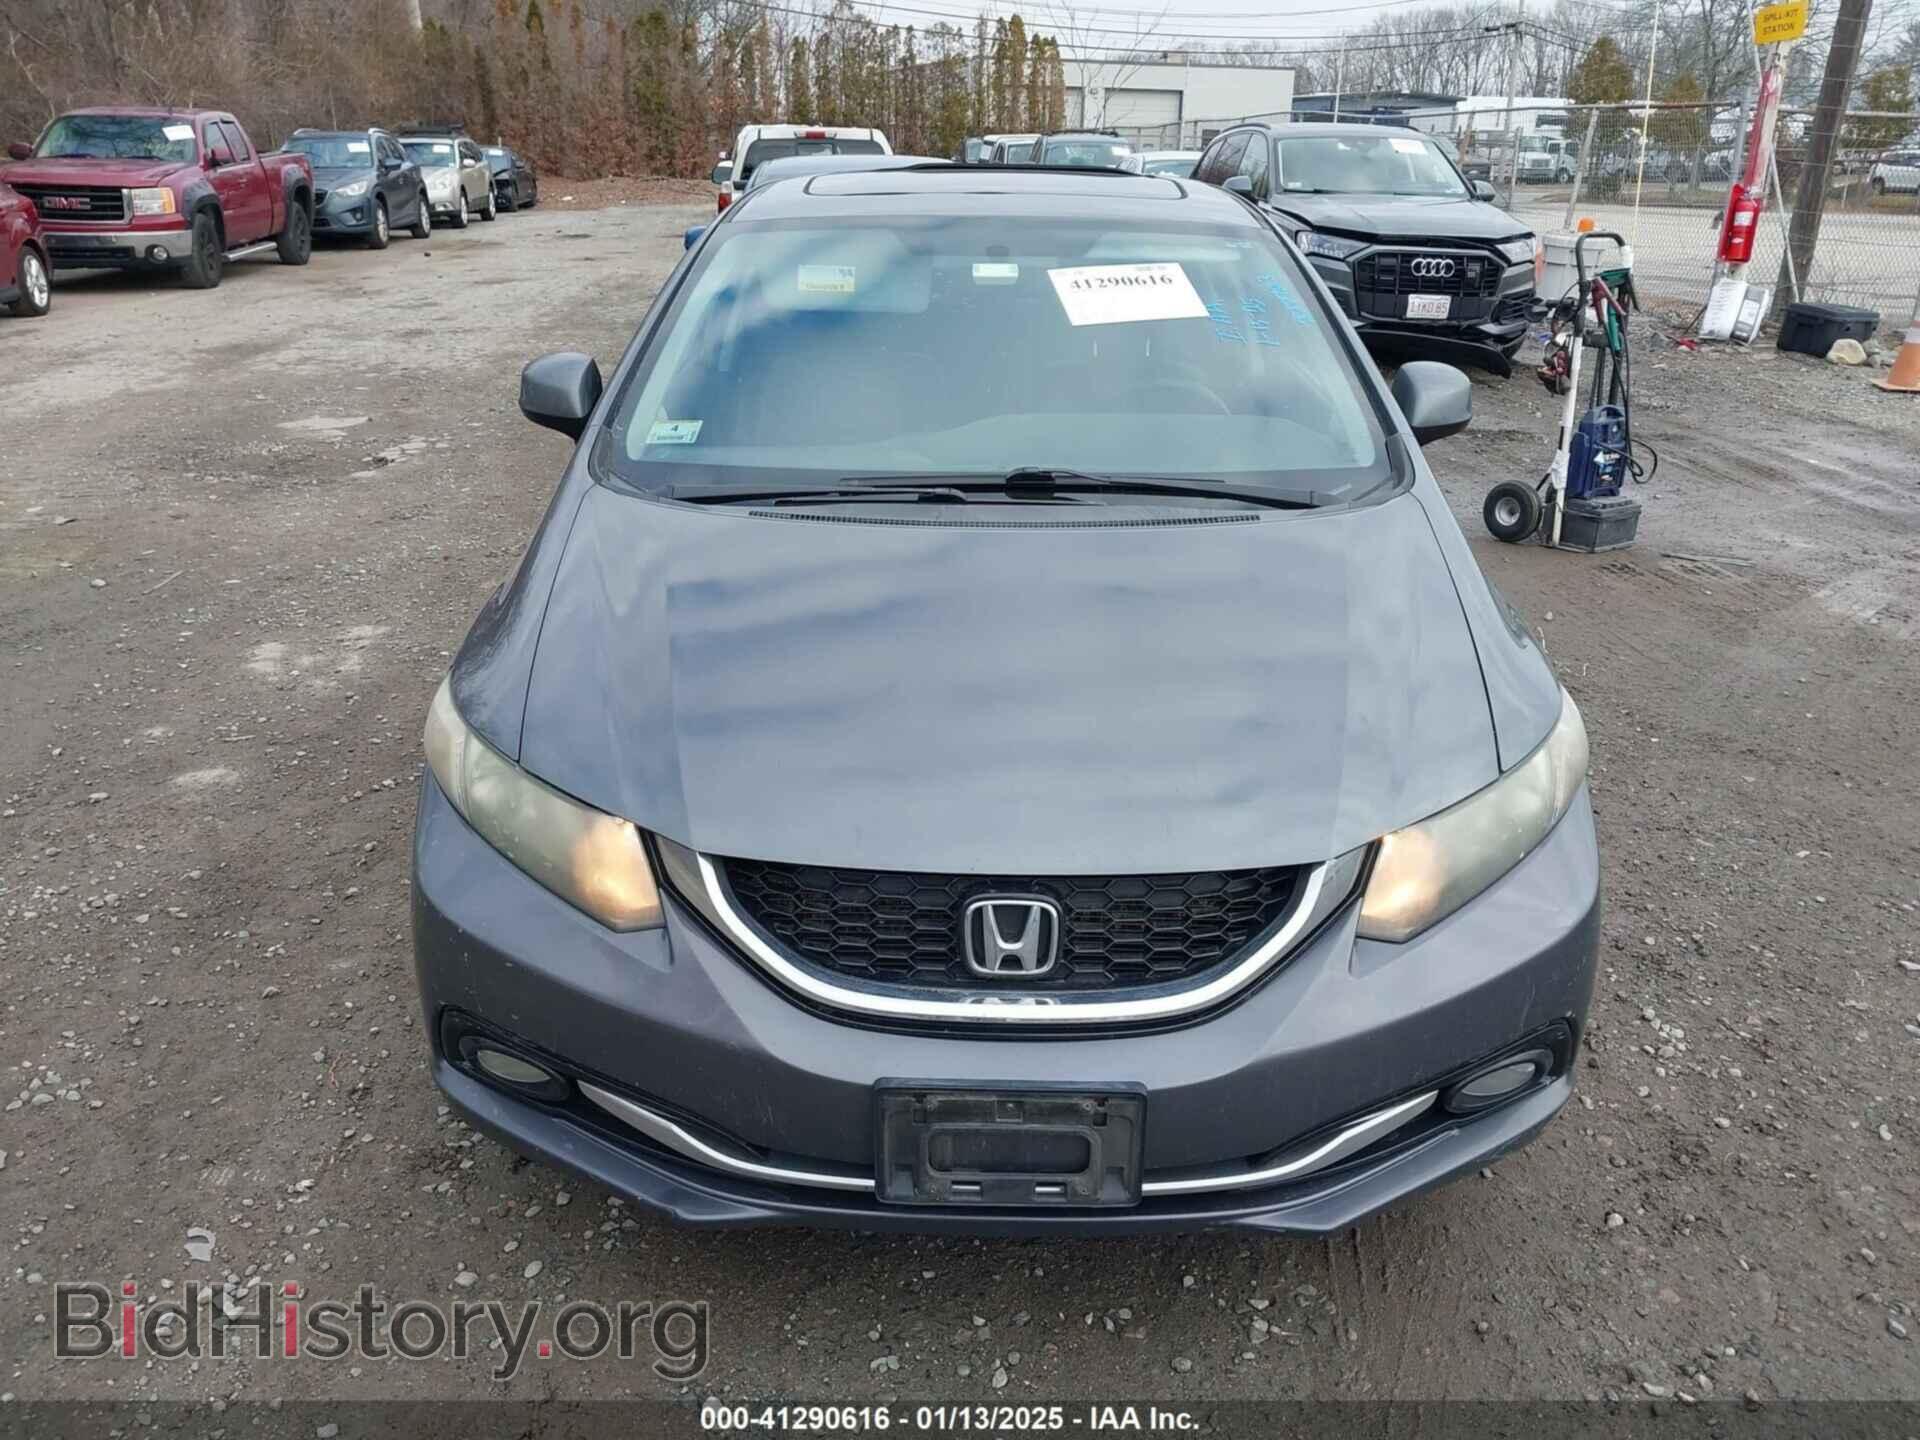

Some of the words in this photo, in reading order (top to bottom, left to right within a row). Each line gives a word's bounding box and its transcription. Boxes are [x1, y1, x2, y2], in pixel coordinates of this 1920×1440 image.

[1763, 22, 1794, 33] STATION
[42, 196, 91, 209] GMC
[1071, 274, 1173, 290] 41290616
